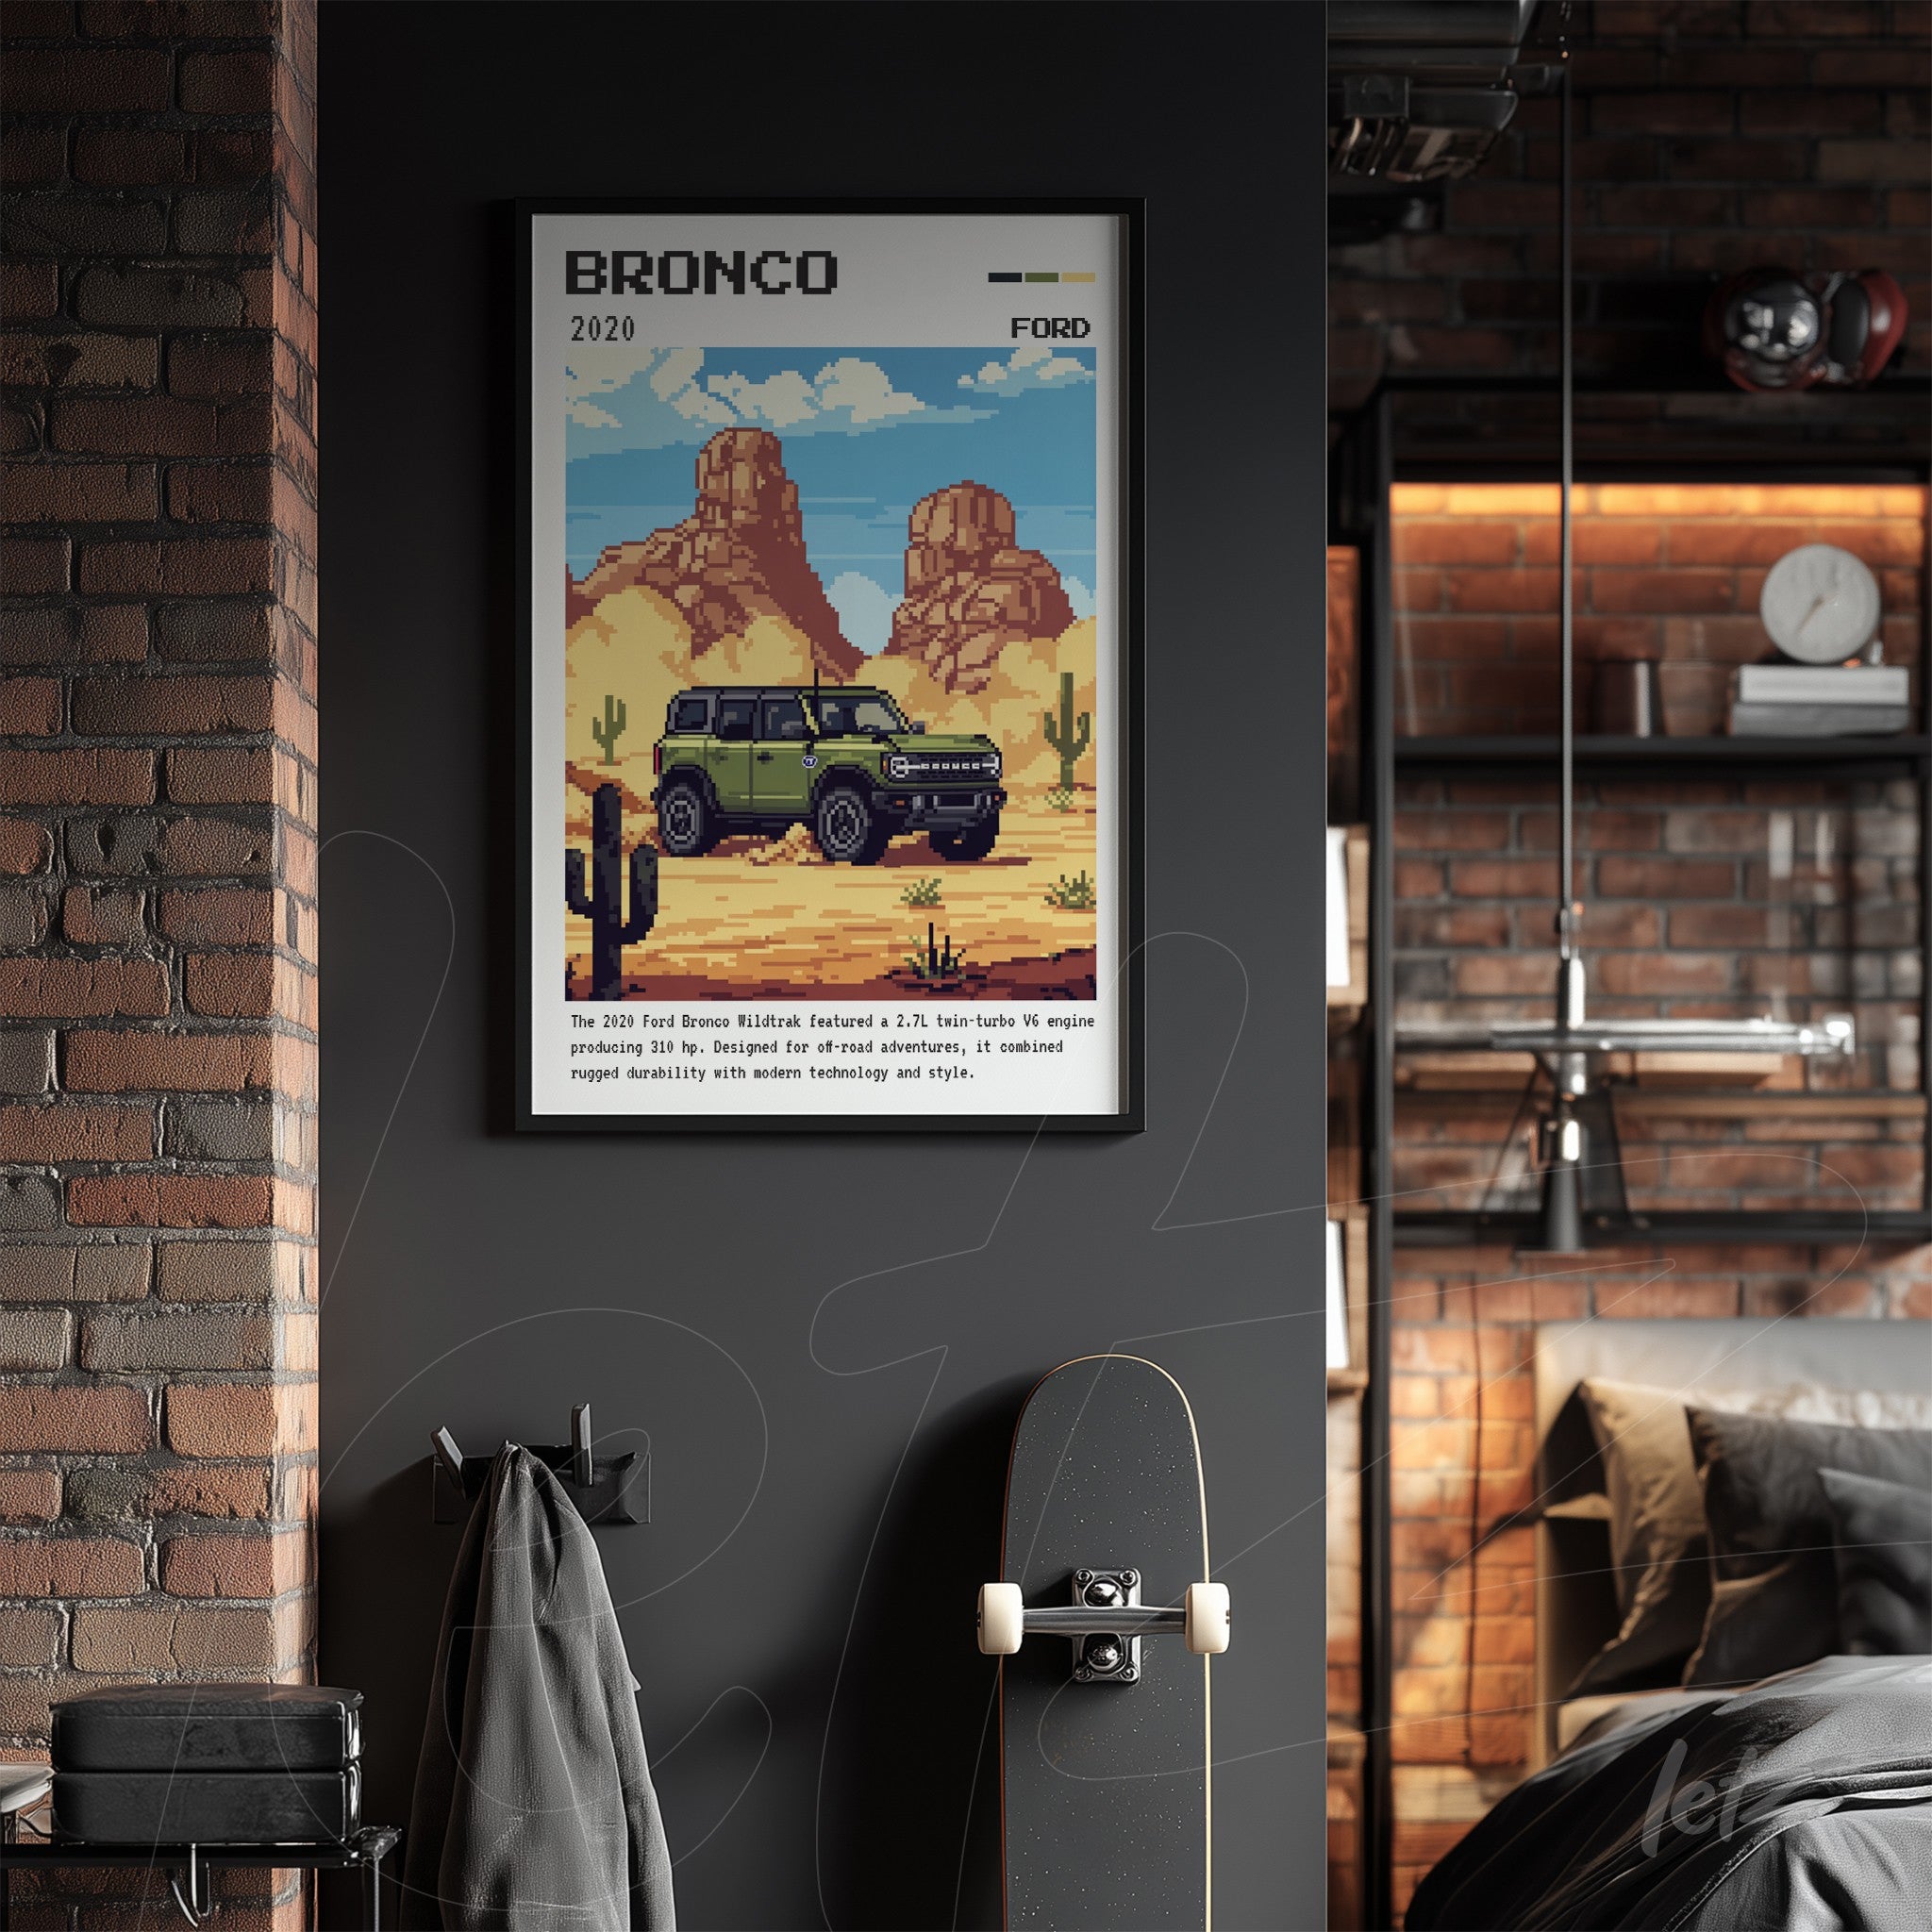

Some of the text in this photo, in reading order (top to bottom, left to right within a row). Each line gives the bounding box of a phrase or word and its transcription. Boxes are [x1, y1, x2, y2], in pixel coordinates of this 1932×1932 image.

[565, 250, 838, 295] BRONCO
[571, 315, 635, 341] 2020
[1010, 317, 1091, 339] FORD
[570, 1013, 1095, 1030] The 2020 Ford Bronco Wildtrak featured a 2.7L twin-turbo V6 engine
[570, 1039, 1063, 1058] producing 310 hp. Designed for off-road adventures, it combined
[570, 1065, 974, 1083] rugged durability with modern technology and style.
